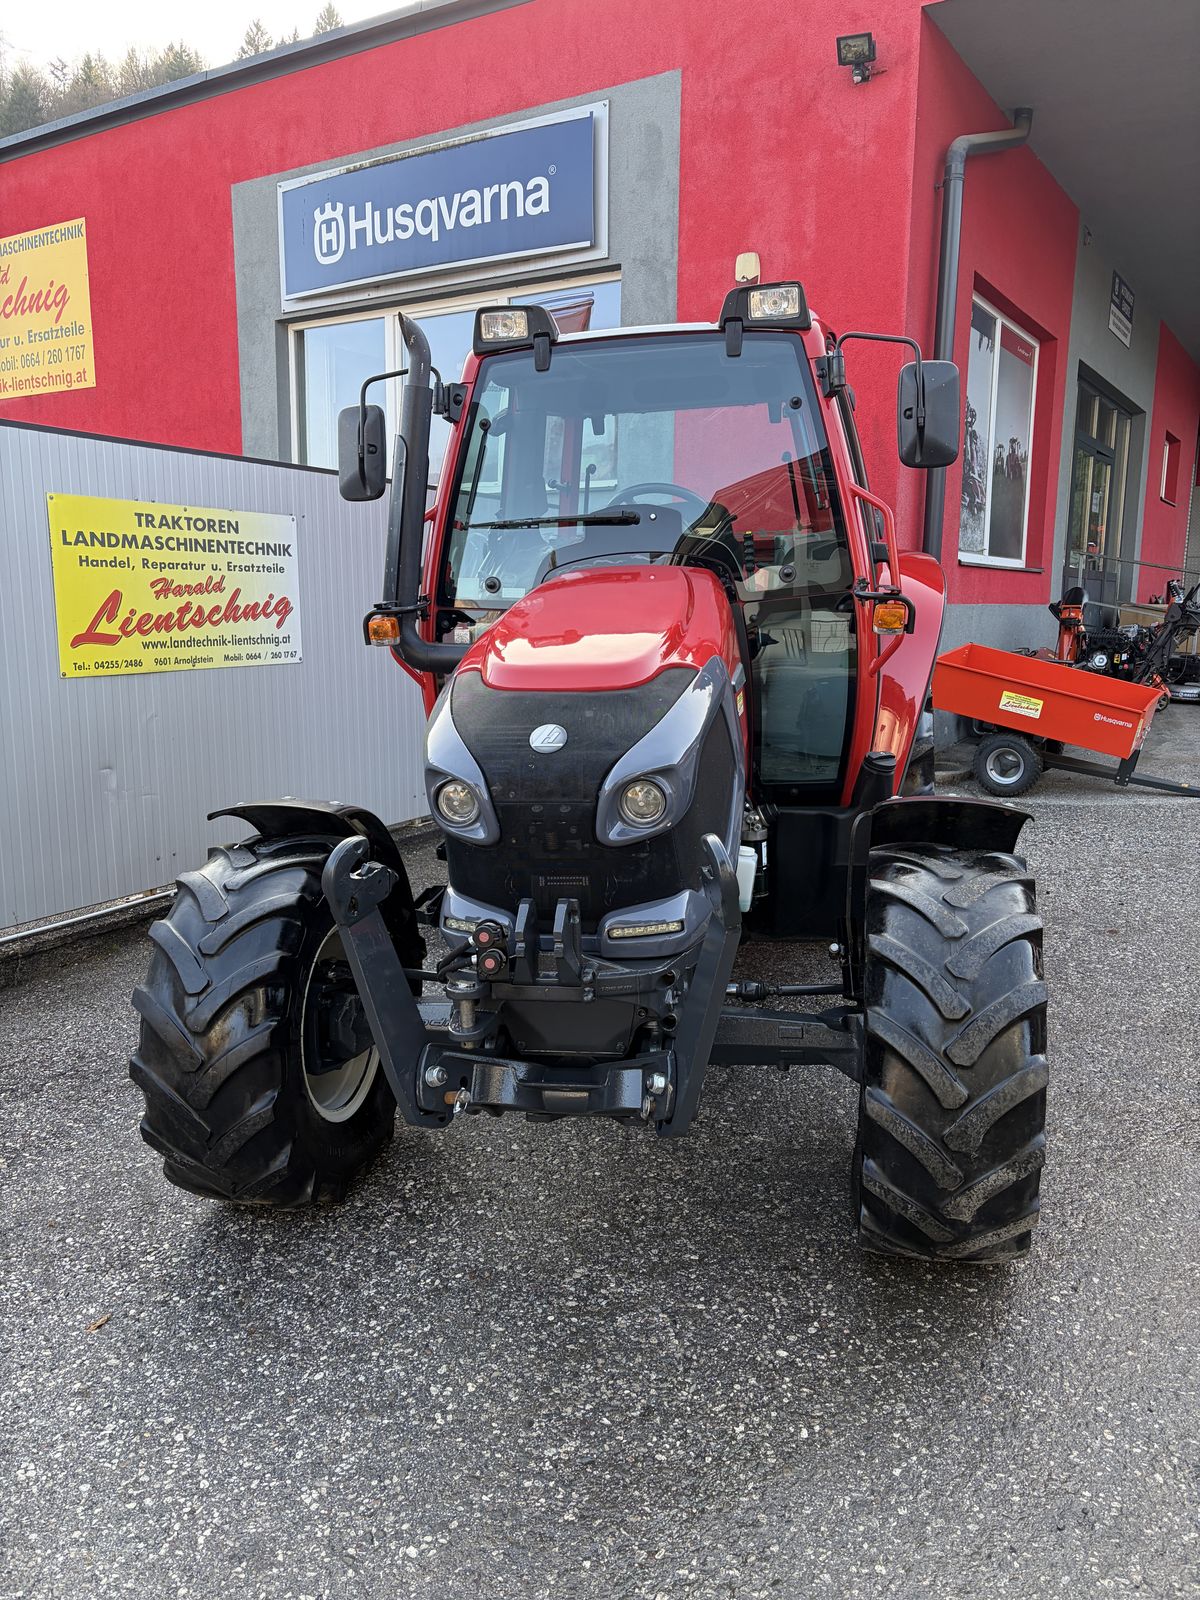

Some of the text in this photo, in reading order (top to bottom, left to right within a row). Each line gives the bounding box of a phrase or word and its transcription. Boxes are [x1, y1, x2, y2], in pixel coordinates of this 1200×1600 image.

[0, 223, 84, 257] ASCHINENTECHNIK
[13, 335, 24, 346] u.
[27, 320, 85, 344] Ersatzteile
[0, 355, 19, 372] obil:
[20, 351, 40, 369] 0664
[47, 348, 63, 365] 260
[65, 344, 86, 362] 1767
[134, 512, 239, 534] TRAKTOREN
[61, 529, 292, 557] LANDMASCHINENTECHNIK
[79, 555, 285, 573] Handel, Reparatur u. Ersatzteile
[150, 574, 226, 600] Harald
[70, 587, 294, 649] Lientschnig
[141, 633, 291, 650] www.landtechnik-lientschnig.at
[73, 662, 91, 671] Tel.:
[94, 659, 143, 670] 04255/2486
[154, 657, 171, 666] 9601
[174, 655, 214, 665] Arnoldstein
[223, 652, 244, 662] Mobil:
[245, 652, 262, 661] 0664
[270, 651, 282, 660] 260
[283, 650, 297, 659] 1767
[1100, 715, 1133, 728] Husqvarna
